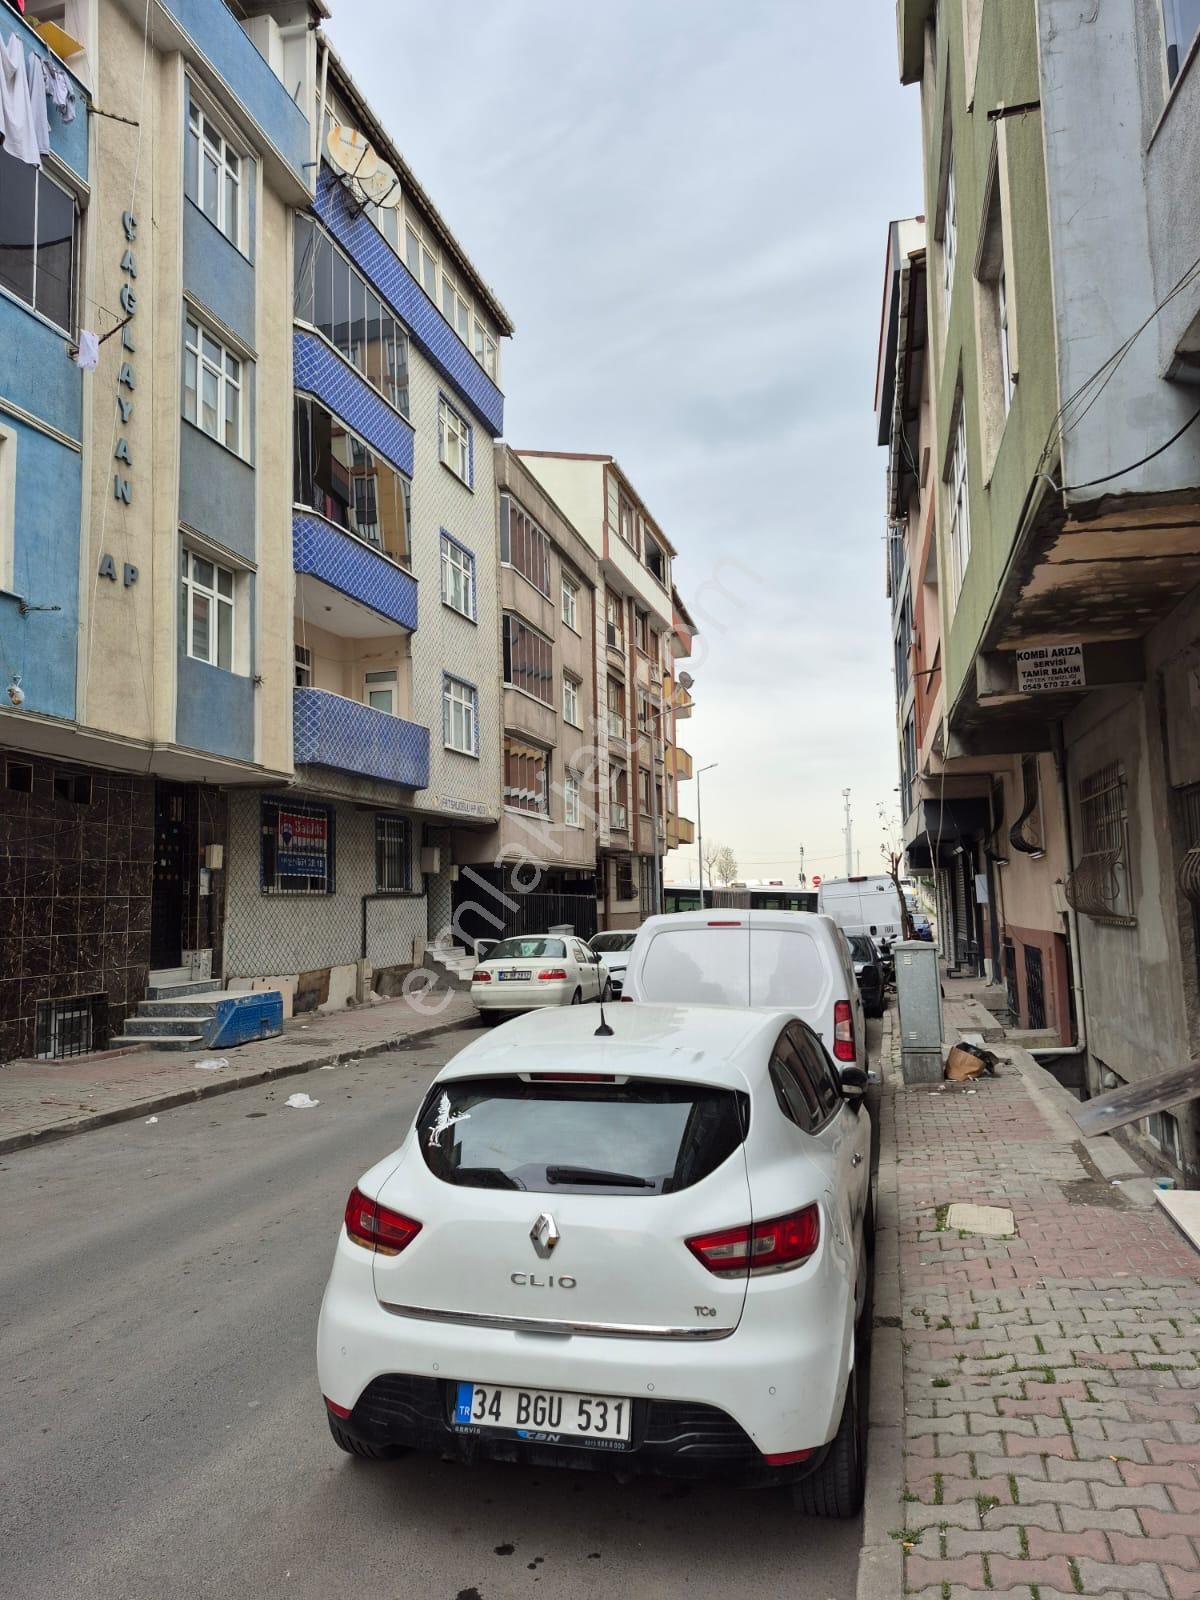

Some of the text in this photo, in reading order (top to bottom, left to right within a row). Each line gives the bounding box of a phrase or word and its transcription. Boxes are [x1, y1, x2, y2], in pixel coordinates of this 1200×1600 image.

[99, 553, 139, 588] AP
[1017, 646, 1081, 661] KOMBİ ARIZA
[1034, 658, 1066, 668] SERVİSİ
[1021, 666, 1081, 678] TAMİR BAKIM
[511, 1272, 577, 1289] CLIO
[694, 1306, 717, 1317] TCe
[459, 1388, 625, 1435] TR 34 BGU 531
